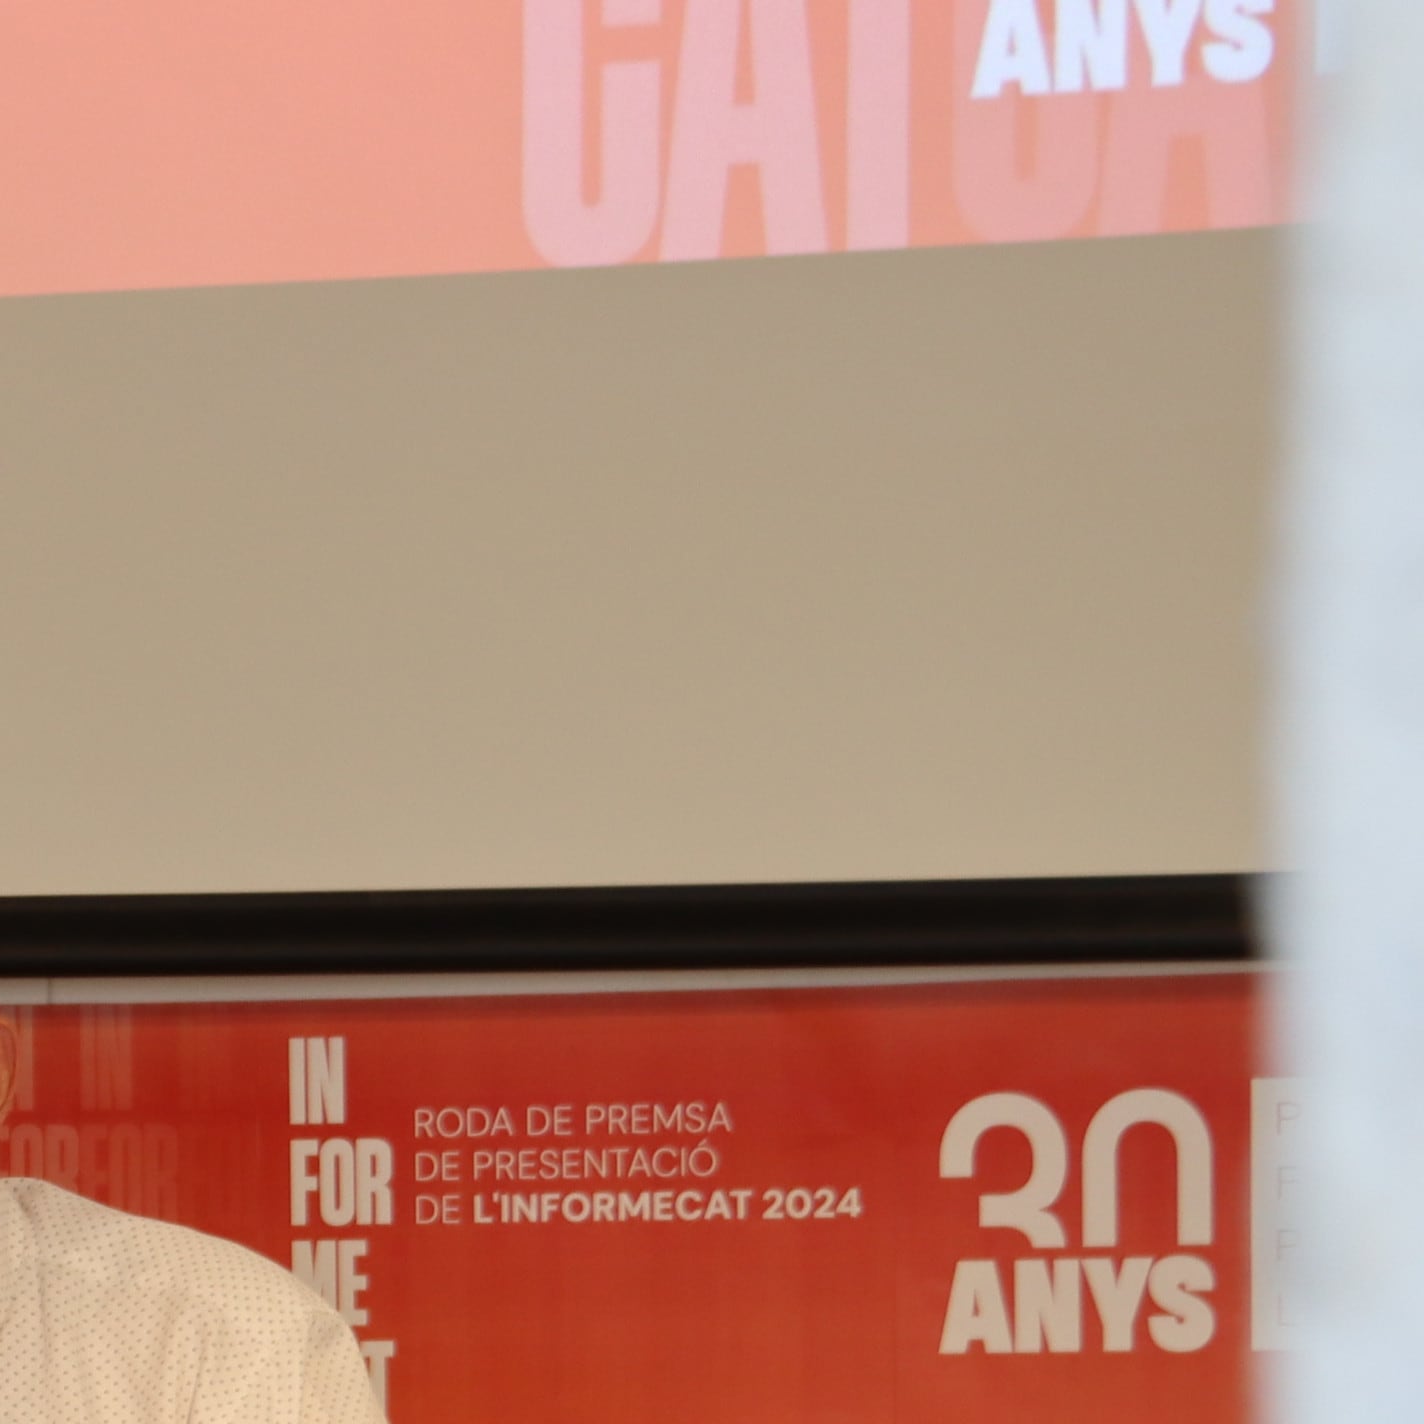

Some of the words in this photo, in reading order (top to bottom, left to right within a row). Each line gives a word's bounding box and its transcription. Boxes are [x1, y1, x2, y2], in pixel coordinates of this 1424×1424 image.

[970, 0, 1276, 99] ANYS
[289, 1036, 345, 1125] IN
[414, 1106, 515, 1138] RODA
[526, 1105, 573, 1135] DE
[585, 1102, 733, 1134] PREMSA
[289, 1138, 393, 1226] FOR
[414, 1151, 460, 1182] DE
[473, 1139, 718, 1180] PRESENTACIÓ
[938, 1087, 1214, 1249] 30
[415, 1195, 460, 1225] DE
[473, 1189, 752, 1224] L'INFORMECAT
[761, 1188, 862, 1220] 2024
[938, 1254, 1216, 1354] ANYS
